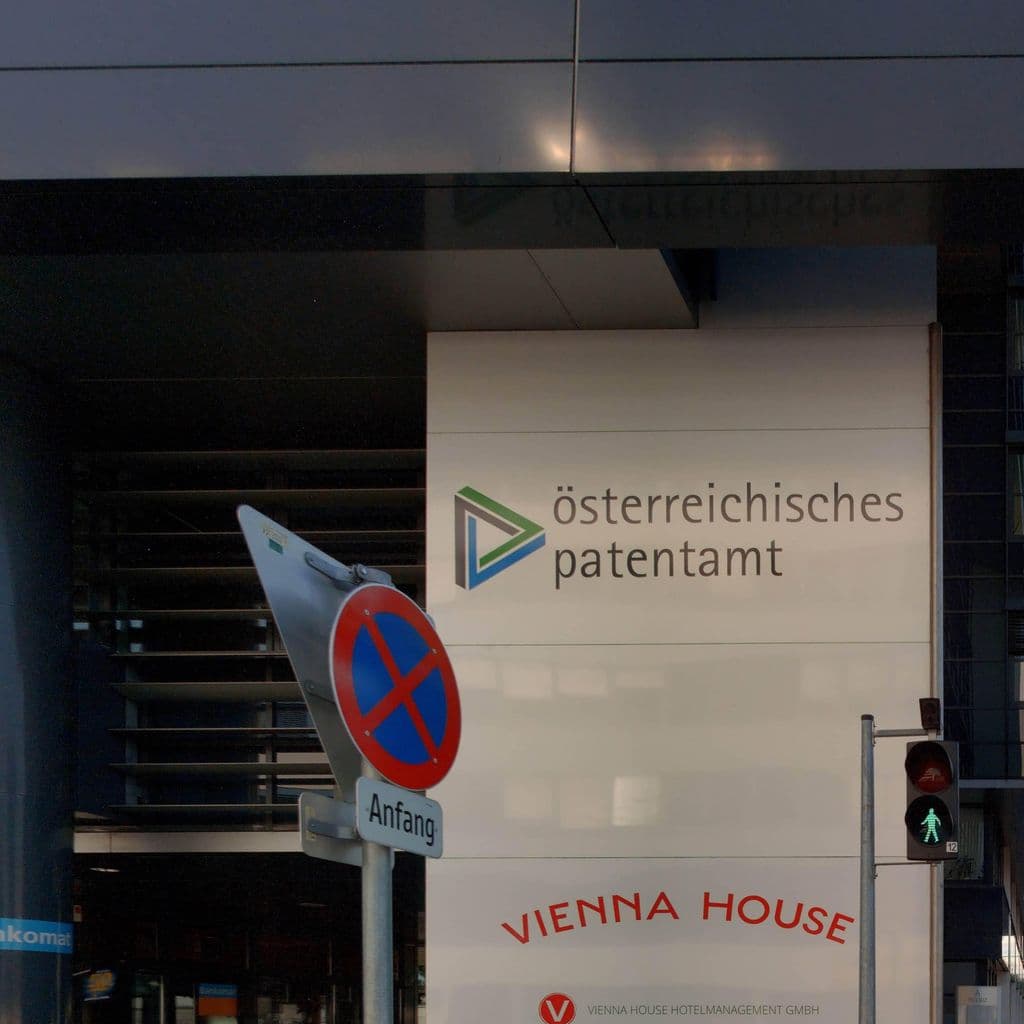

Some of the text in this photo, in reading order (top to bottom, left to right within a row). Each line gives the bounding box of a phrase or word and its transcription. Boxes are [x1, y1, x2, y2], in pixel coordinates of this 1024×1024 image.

[553, 482, 904, 526] österreichisches
[555, 540, 783, 590] patentamt
[369, 793, 434, 846] Anfang
[501, 891, 855, 945] VIENNA HOUSE
[588, 1005, 820, 1015] VIENNA HOUSE HOTELMANAGEMENT GMBH
